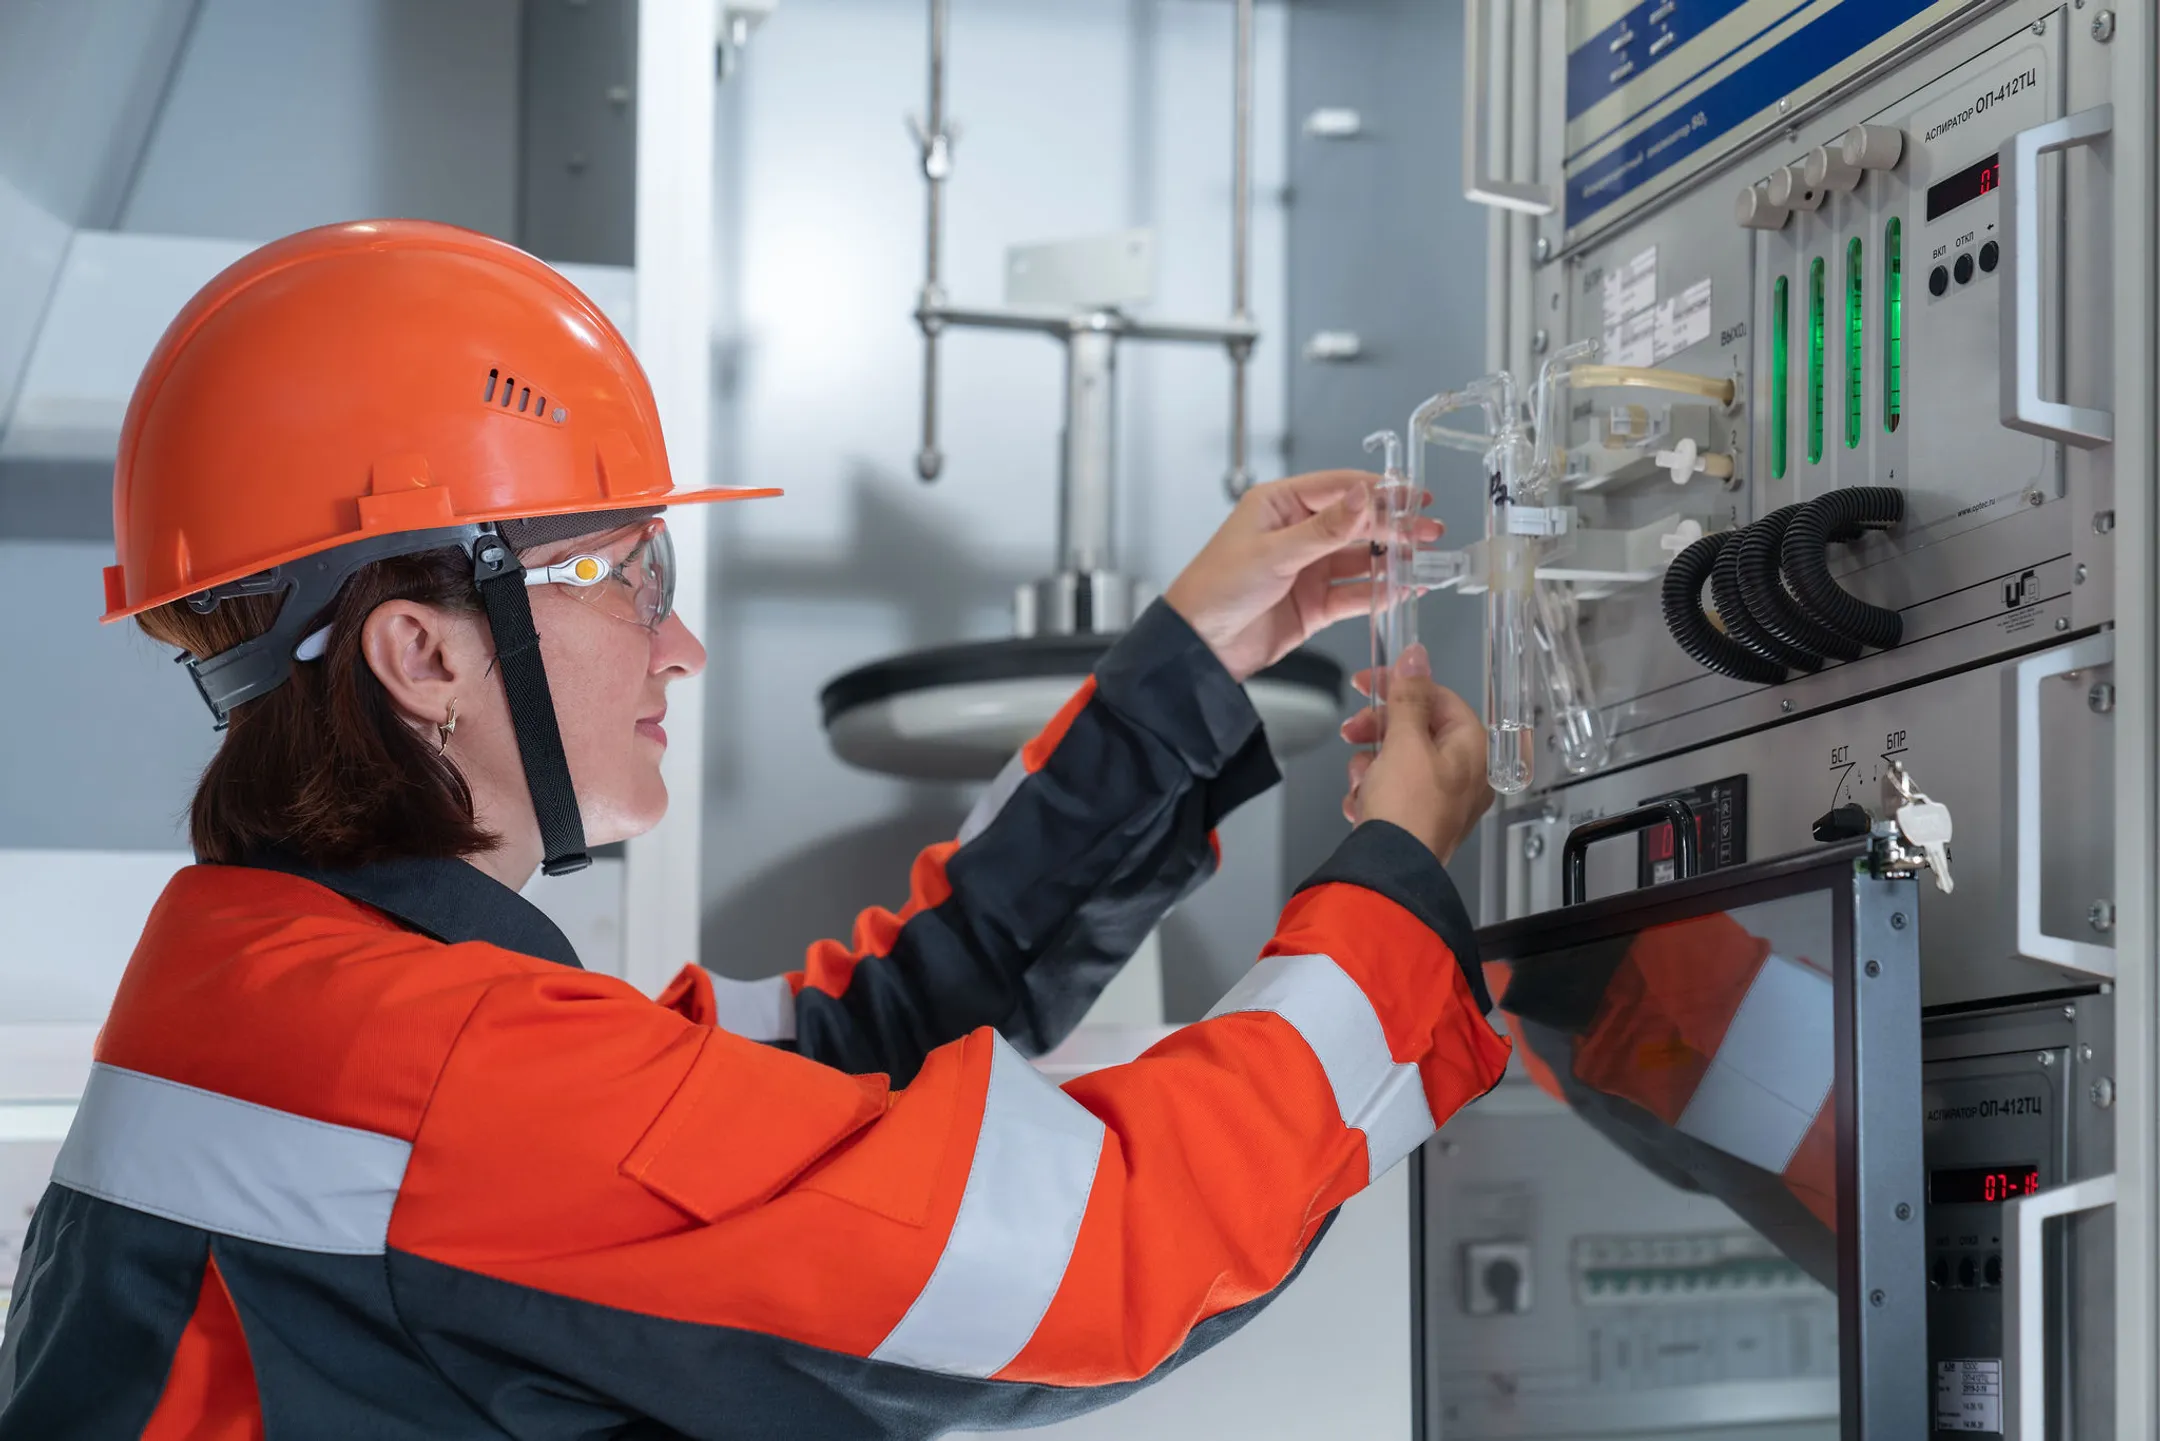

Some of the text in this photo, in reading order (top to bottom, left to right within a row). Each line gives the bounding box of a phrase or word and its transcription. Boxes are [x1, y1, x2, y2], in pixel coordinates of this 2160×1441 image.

[1925, 67, 2036, 143] АСПИРАТОР ОП-412ТЦ
[1955, 231, 1974, 247] ОТКЛ
[1932, 244, 1947, 259] ВКЛ
[1957, 497, 1996, 517] www.optec.ru
[1886, 730, 1906, 750] БПР
[1831, 745, 1849, 765] БСТ
[1927, 1097, 2042, 1121] АСПИРАТОР ОП-412ТЦ
